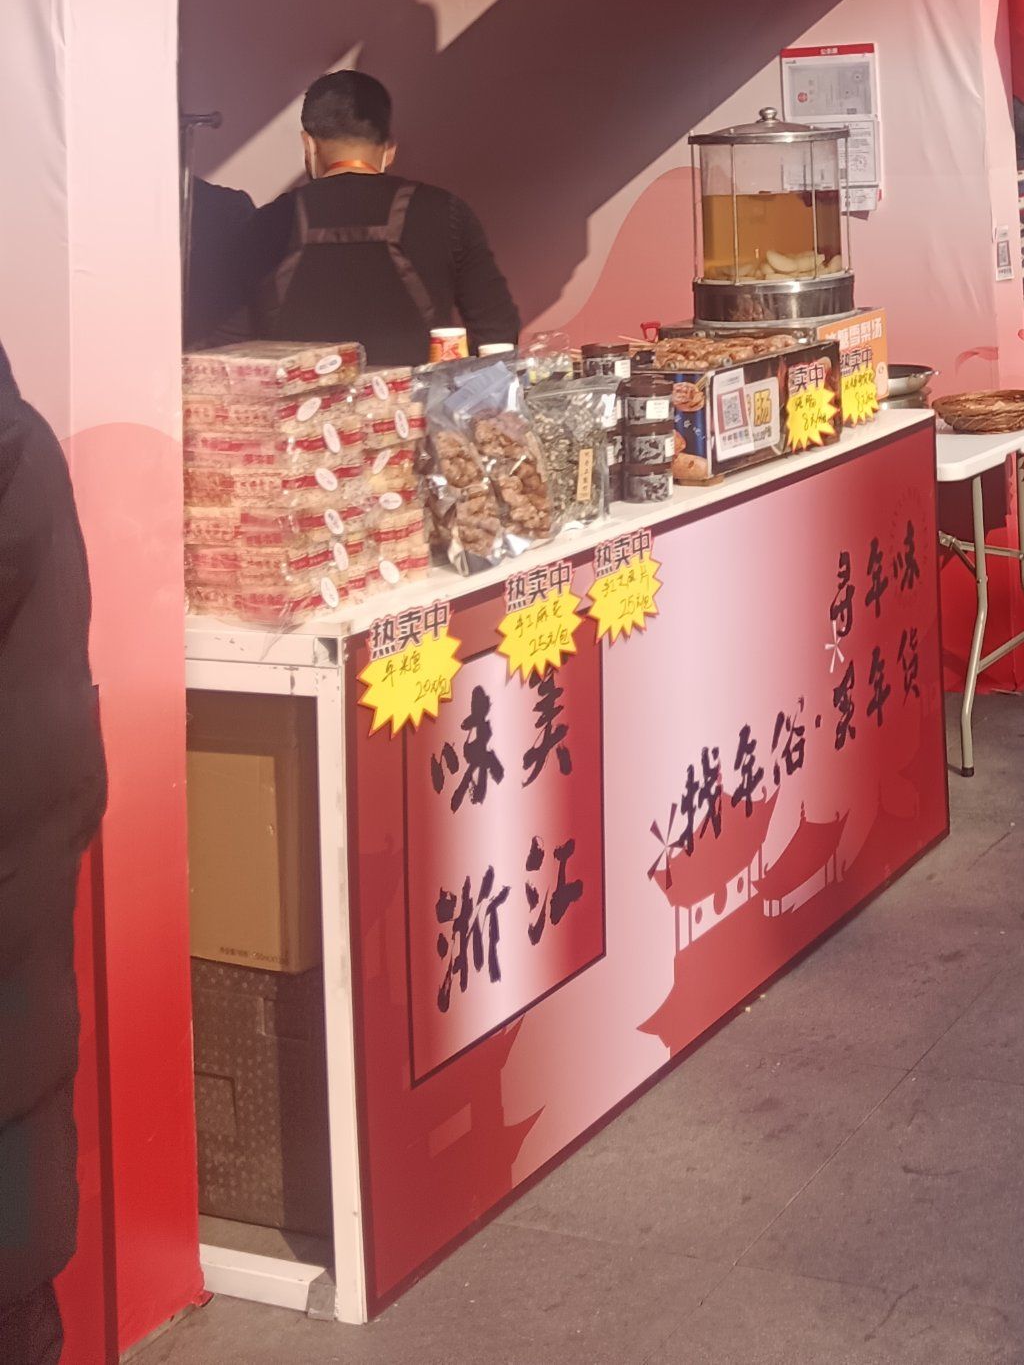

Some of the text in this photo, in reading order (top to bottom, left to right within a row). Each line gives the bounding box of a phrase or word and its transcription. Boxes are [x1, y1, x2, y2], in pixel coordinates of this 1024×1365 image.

[786, 364, 824, 393] 卖中
[597, 531, 650, 577] 热卖中
[508, 561, 570, 612] 热卖中
[372, 602, 448, 660] 热卖中
[436, 835, 584, 1014] 浙江
